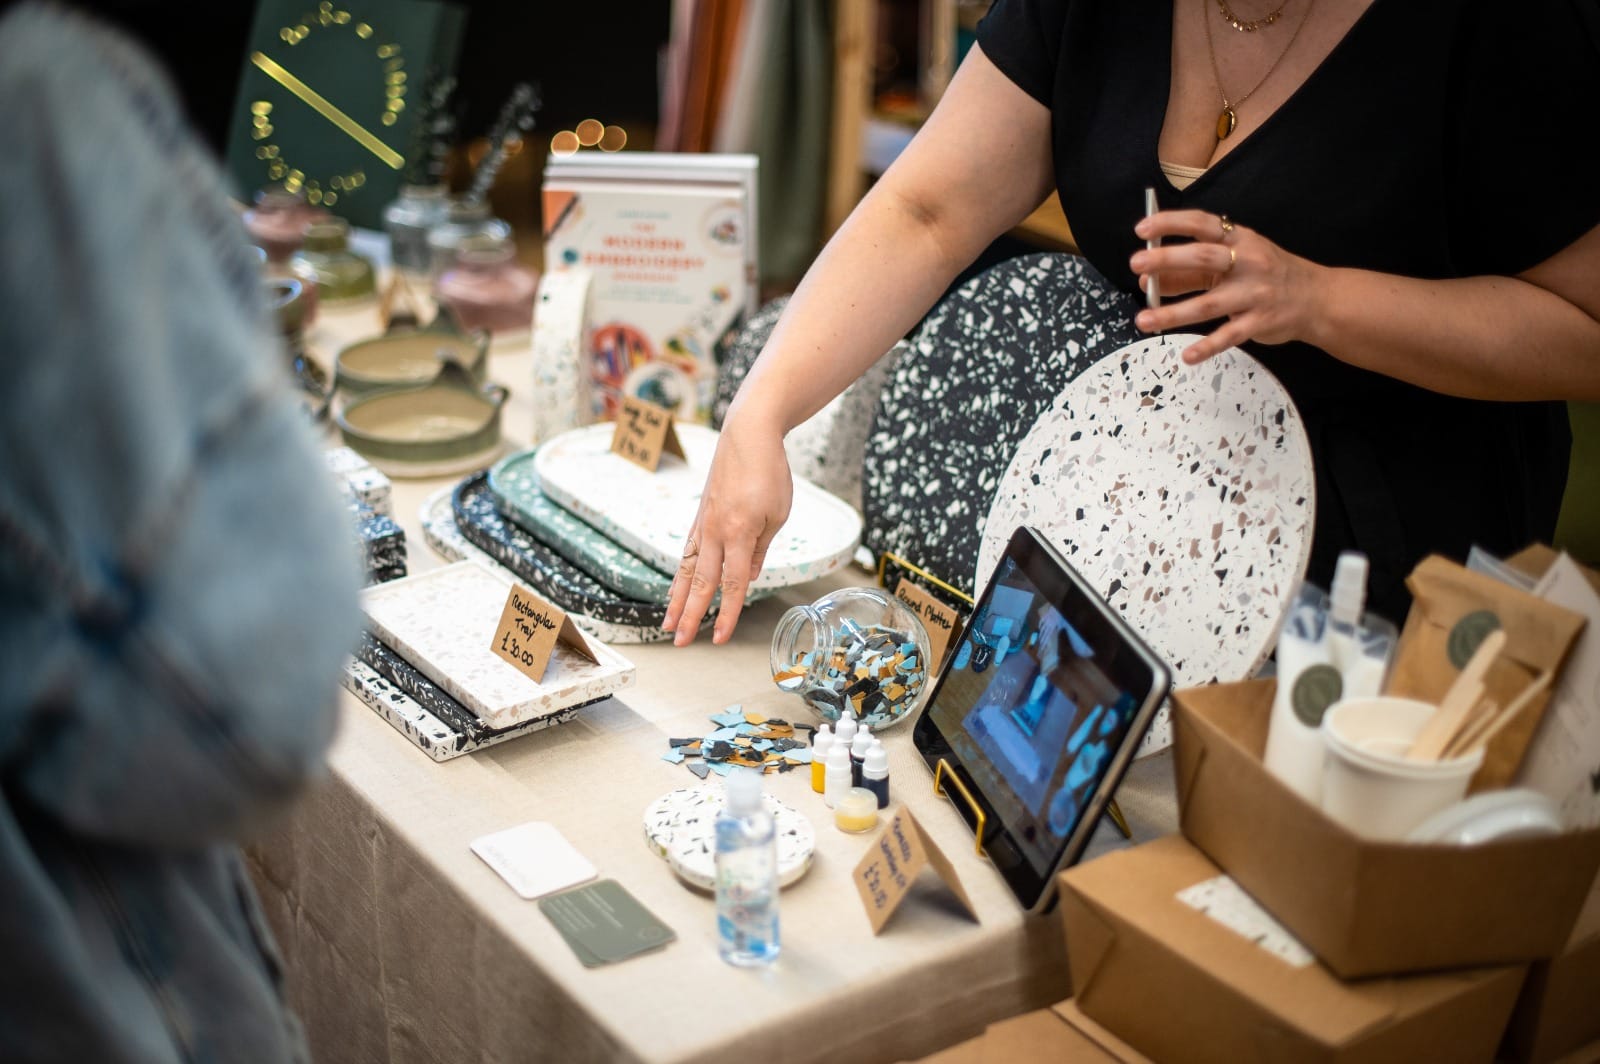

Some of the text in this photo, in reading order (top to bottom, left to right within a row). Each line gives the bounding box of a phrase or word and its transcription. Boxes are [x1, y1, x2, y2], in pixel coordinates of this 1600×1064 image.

[512, 594, 556, 630] Rectangular
[899, 587, 951, 630] Round Platter
[515, 618, 535, 642] Tray
